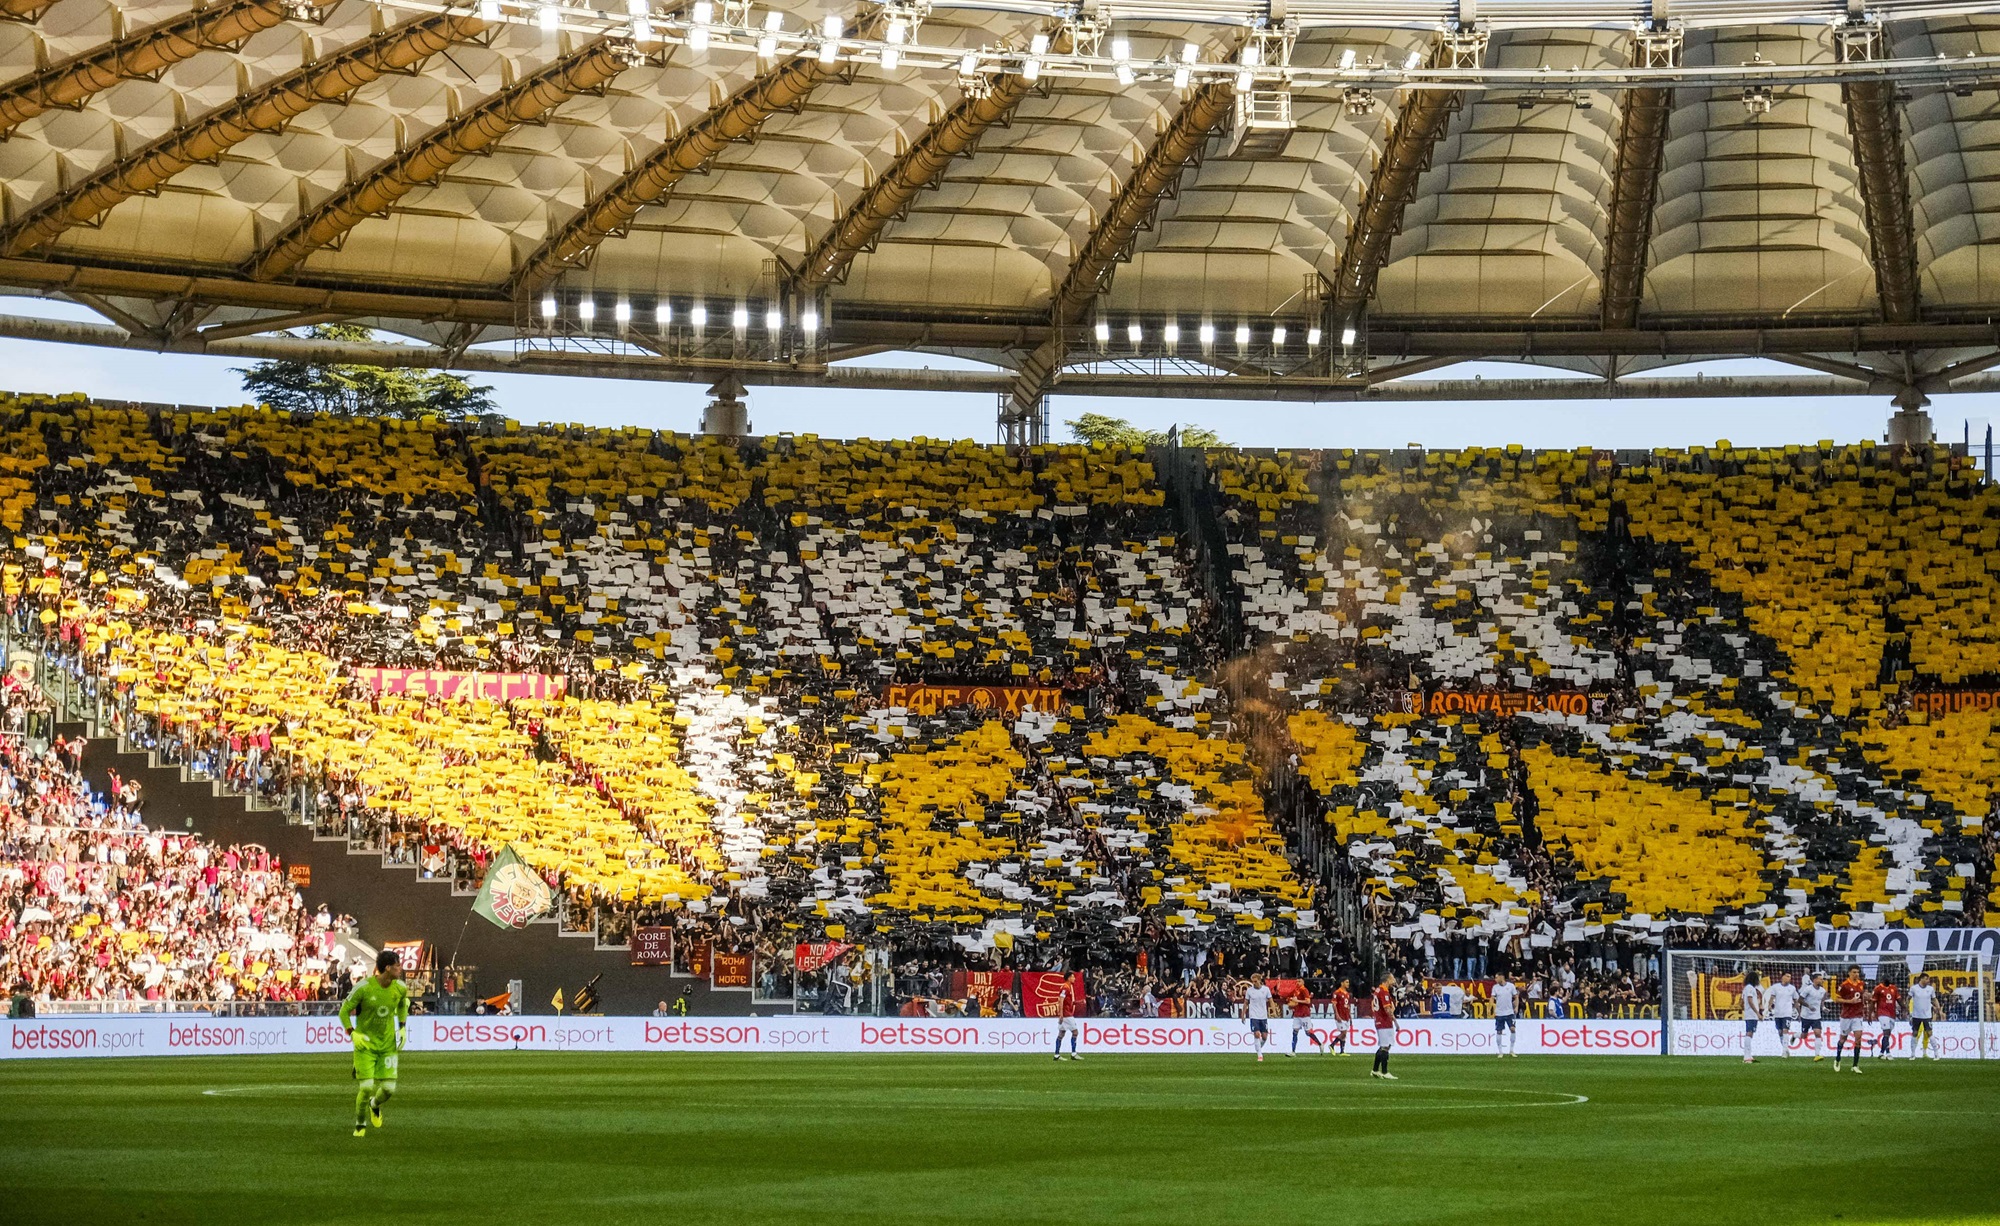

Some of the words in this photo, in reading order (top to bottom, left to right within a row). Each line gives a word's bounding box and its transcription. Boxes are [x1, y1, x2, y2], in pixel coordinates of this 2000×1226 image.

[889, 687, 960, 715] GATE
[638, 932, 667, 941] CORE
[644, 942, 659, 950] DE
[637, 950, 668, 959] ROMA
[730, 966, 737, 975] O
[12, 1024, 145, 1050] betsson.sport
[169, 1022, 288, 1048] betsson.sport
[433, 1020, 614, 1047] betsson.sport
[645, 1021, 830, 1048] betsson.sport
[861, 1022, 1051, 1048] betsson.sport
[1083, 1022, 1277, 1049] betsson.spot
